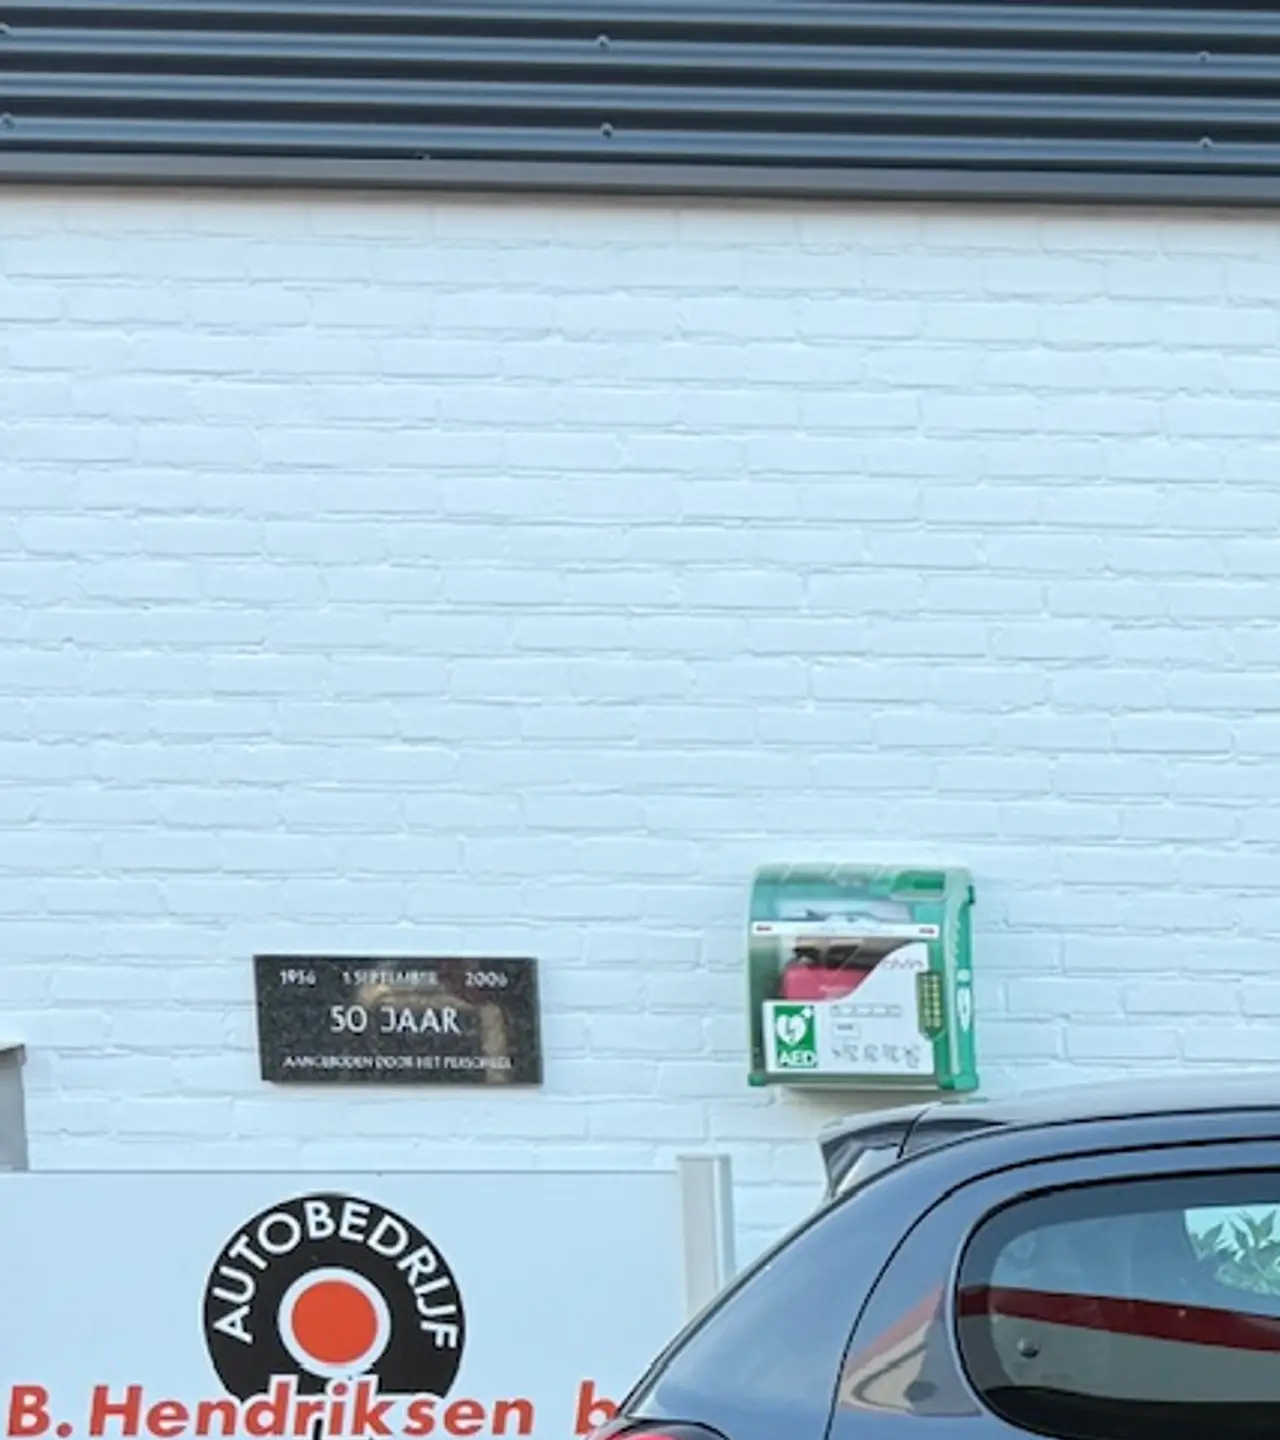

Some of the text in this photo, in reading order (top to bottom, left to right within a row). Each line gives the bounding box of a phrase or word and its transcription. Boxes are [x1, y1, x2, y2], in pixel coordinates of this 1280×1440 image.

[280, 969, 317, 986] 1956
[465, 971, 509, 988] 2006
[330, 1005, 461, 1035] 50 JAAR
[780, 1050, 819, 1067] AED
[213, 1199, 457, 1349] AUTOBEDRIJF
[7, 1384, 73, 1439] B.
[89, 1380, 535, 1439] Hendriksen
